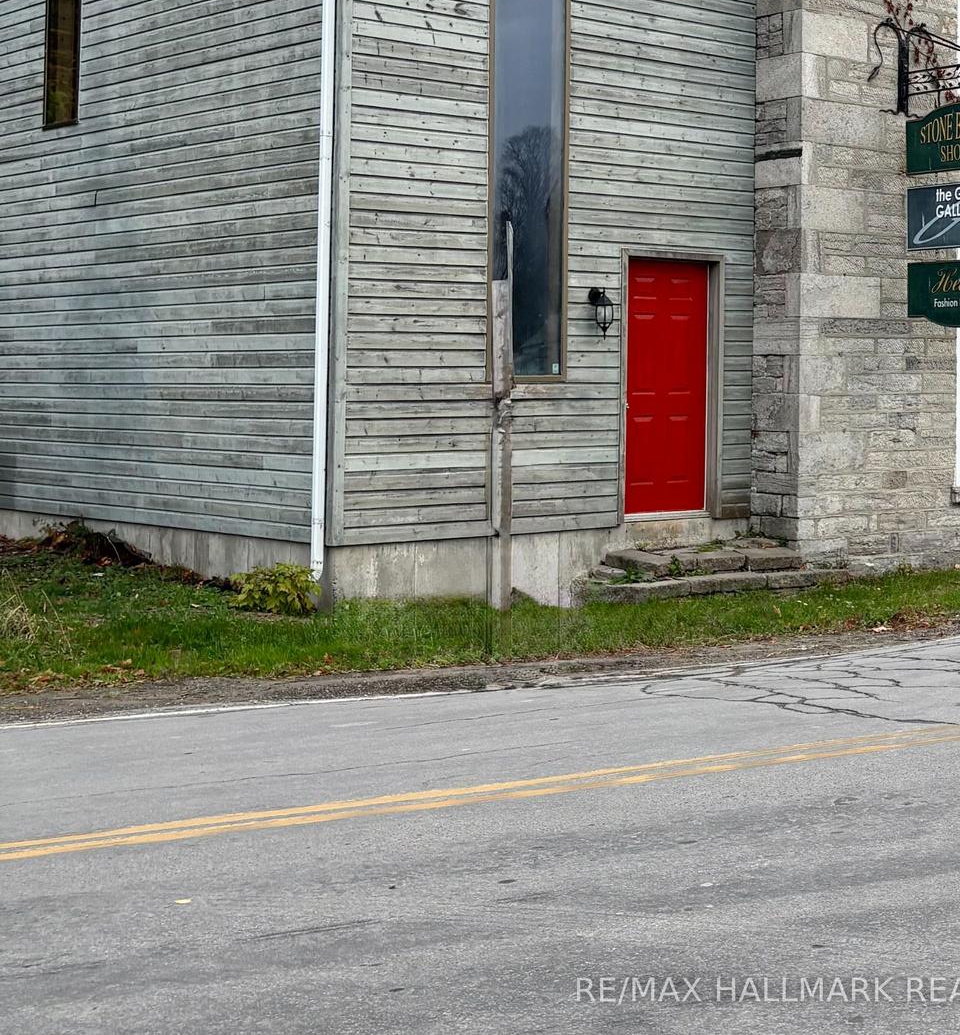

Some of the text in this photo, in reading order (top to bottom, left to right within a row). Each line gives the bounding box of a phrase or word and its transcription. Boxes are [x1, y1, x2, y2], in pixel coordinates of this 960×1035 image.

[920, 113, 953, 144] STONE
[936, 188, 952, 202] the
[934, 298, 959, 308] Fashion
